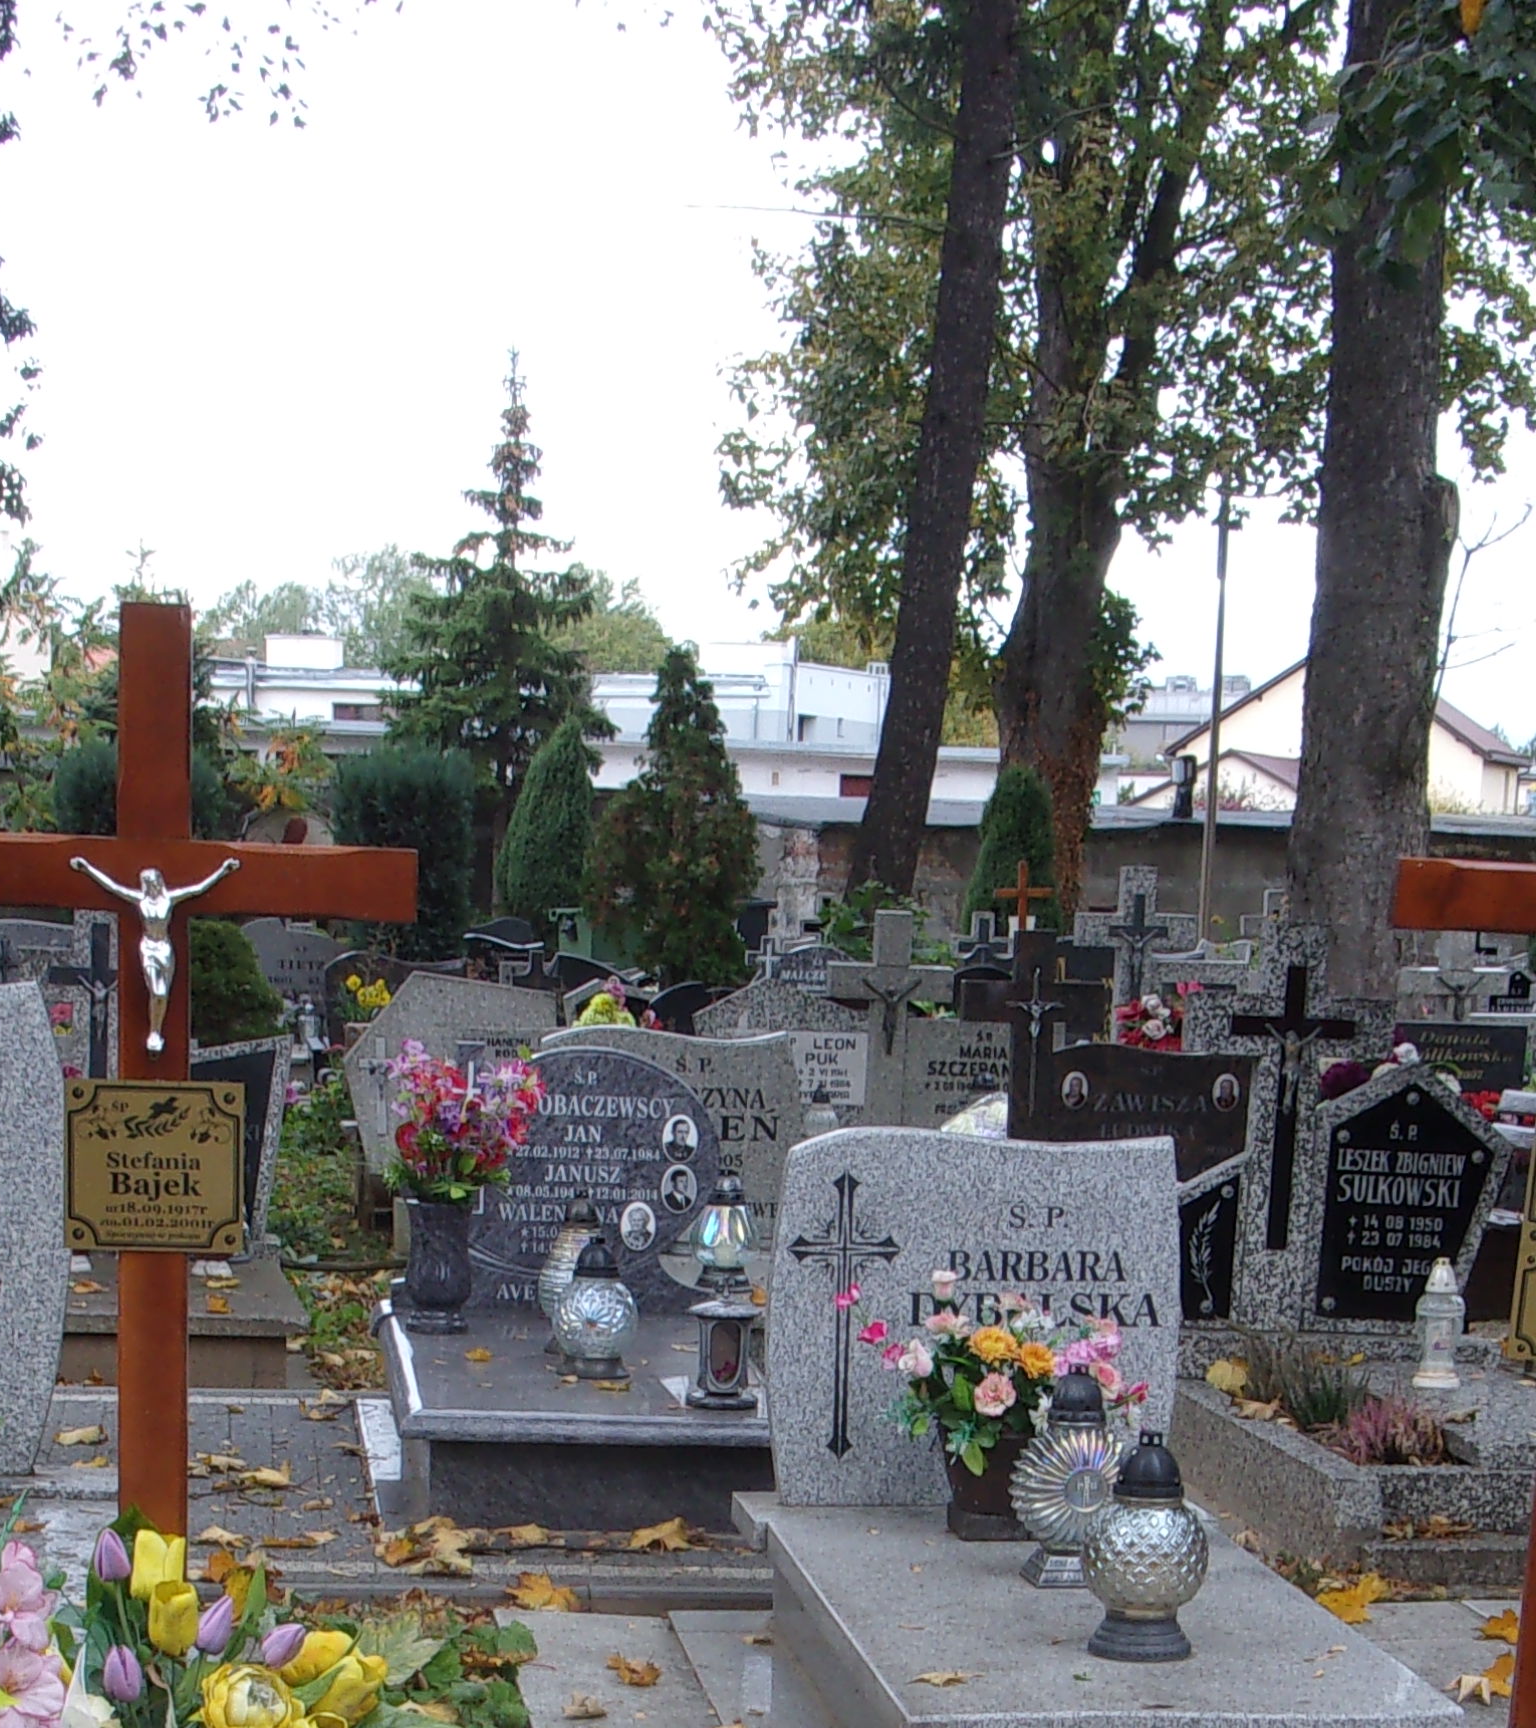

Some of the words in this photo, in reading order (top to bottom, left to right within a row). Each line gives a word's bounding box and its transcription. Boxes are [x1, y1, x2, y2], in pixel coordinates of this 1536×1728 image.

[813, 1037, 857, 1051] LEON
[959, 1044, 1008, 1060] MARIA
[804, 1052, 839, 1066] PUK
[927, 1060, 1010, 1078] SZCZEPAN
[538, 1093, 676, 1119] OBACZEWSCY
[1093, 1093, 1209, 1113] ZAWISZA
[563, 1124, 602, 1143] JAN
[106, 1151, 201, 1171] Stefania
[1336, 1148, 1393, 1173] LESZEK
[1395, 1152, 1466, 1176] ZBIGNIEW
[544, 1163, 623, 1184] JANUSZ
[109, 1171, 202, 1201] Bajek
[1336, 1174, 1463, 1208] SULKOWSKI
[498, 1203, 619, 1225] WALENNA
[1364, 1214, 1379, 1229] 14
[1409, 1217, 1444, 1232] 1950
[1361, 1231, 1380, 1246] 23
[1386, 1232, 1403, 1247] 07
[1408, 1233, 1442, 1249] 1984
[948, 1249, 1127, 1282] BARBARA
[1341, 1255, 1394, 1274] POKÓJ
[1401, 1258, 1434, 1275] JEG
[1363, 1275, 1414, 1293] DUSZY
